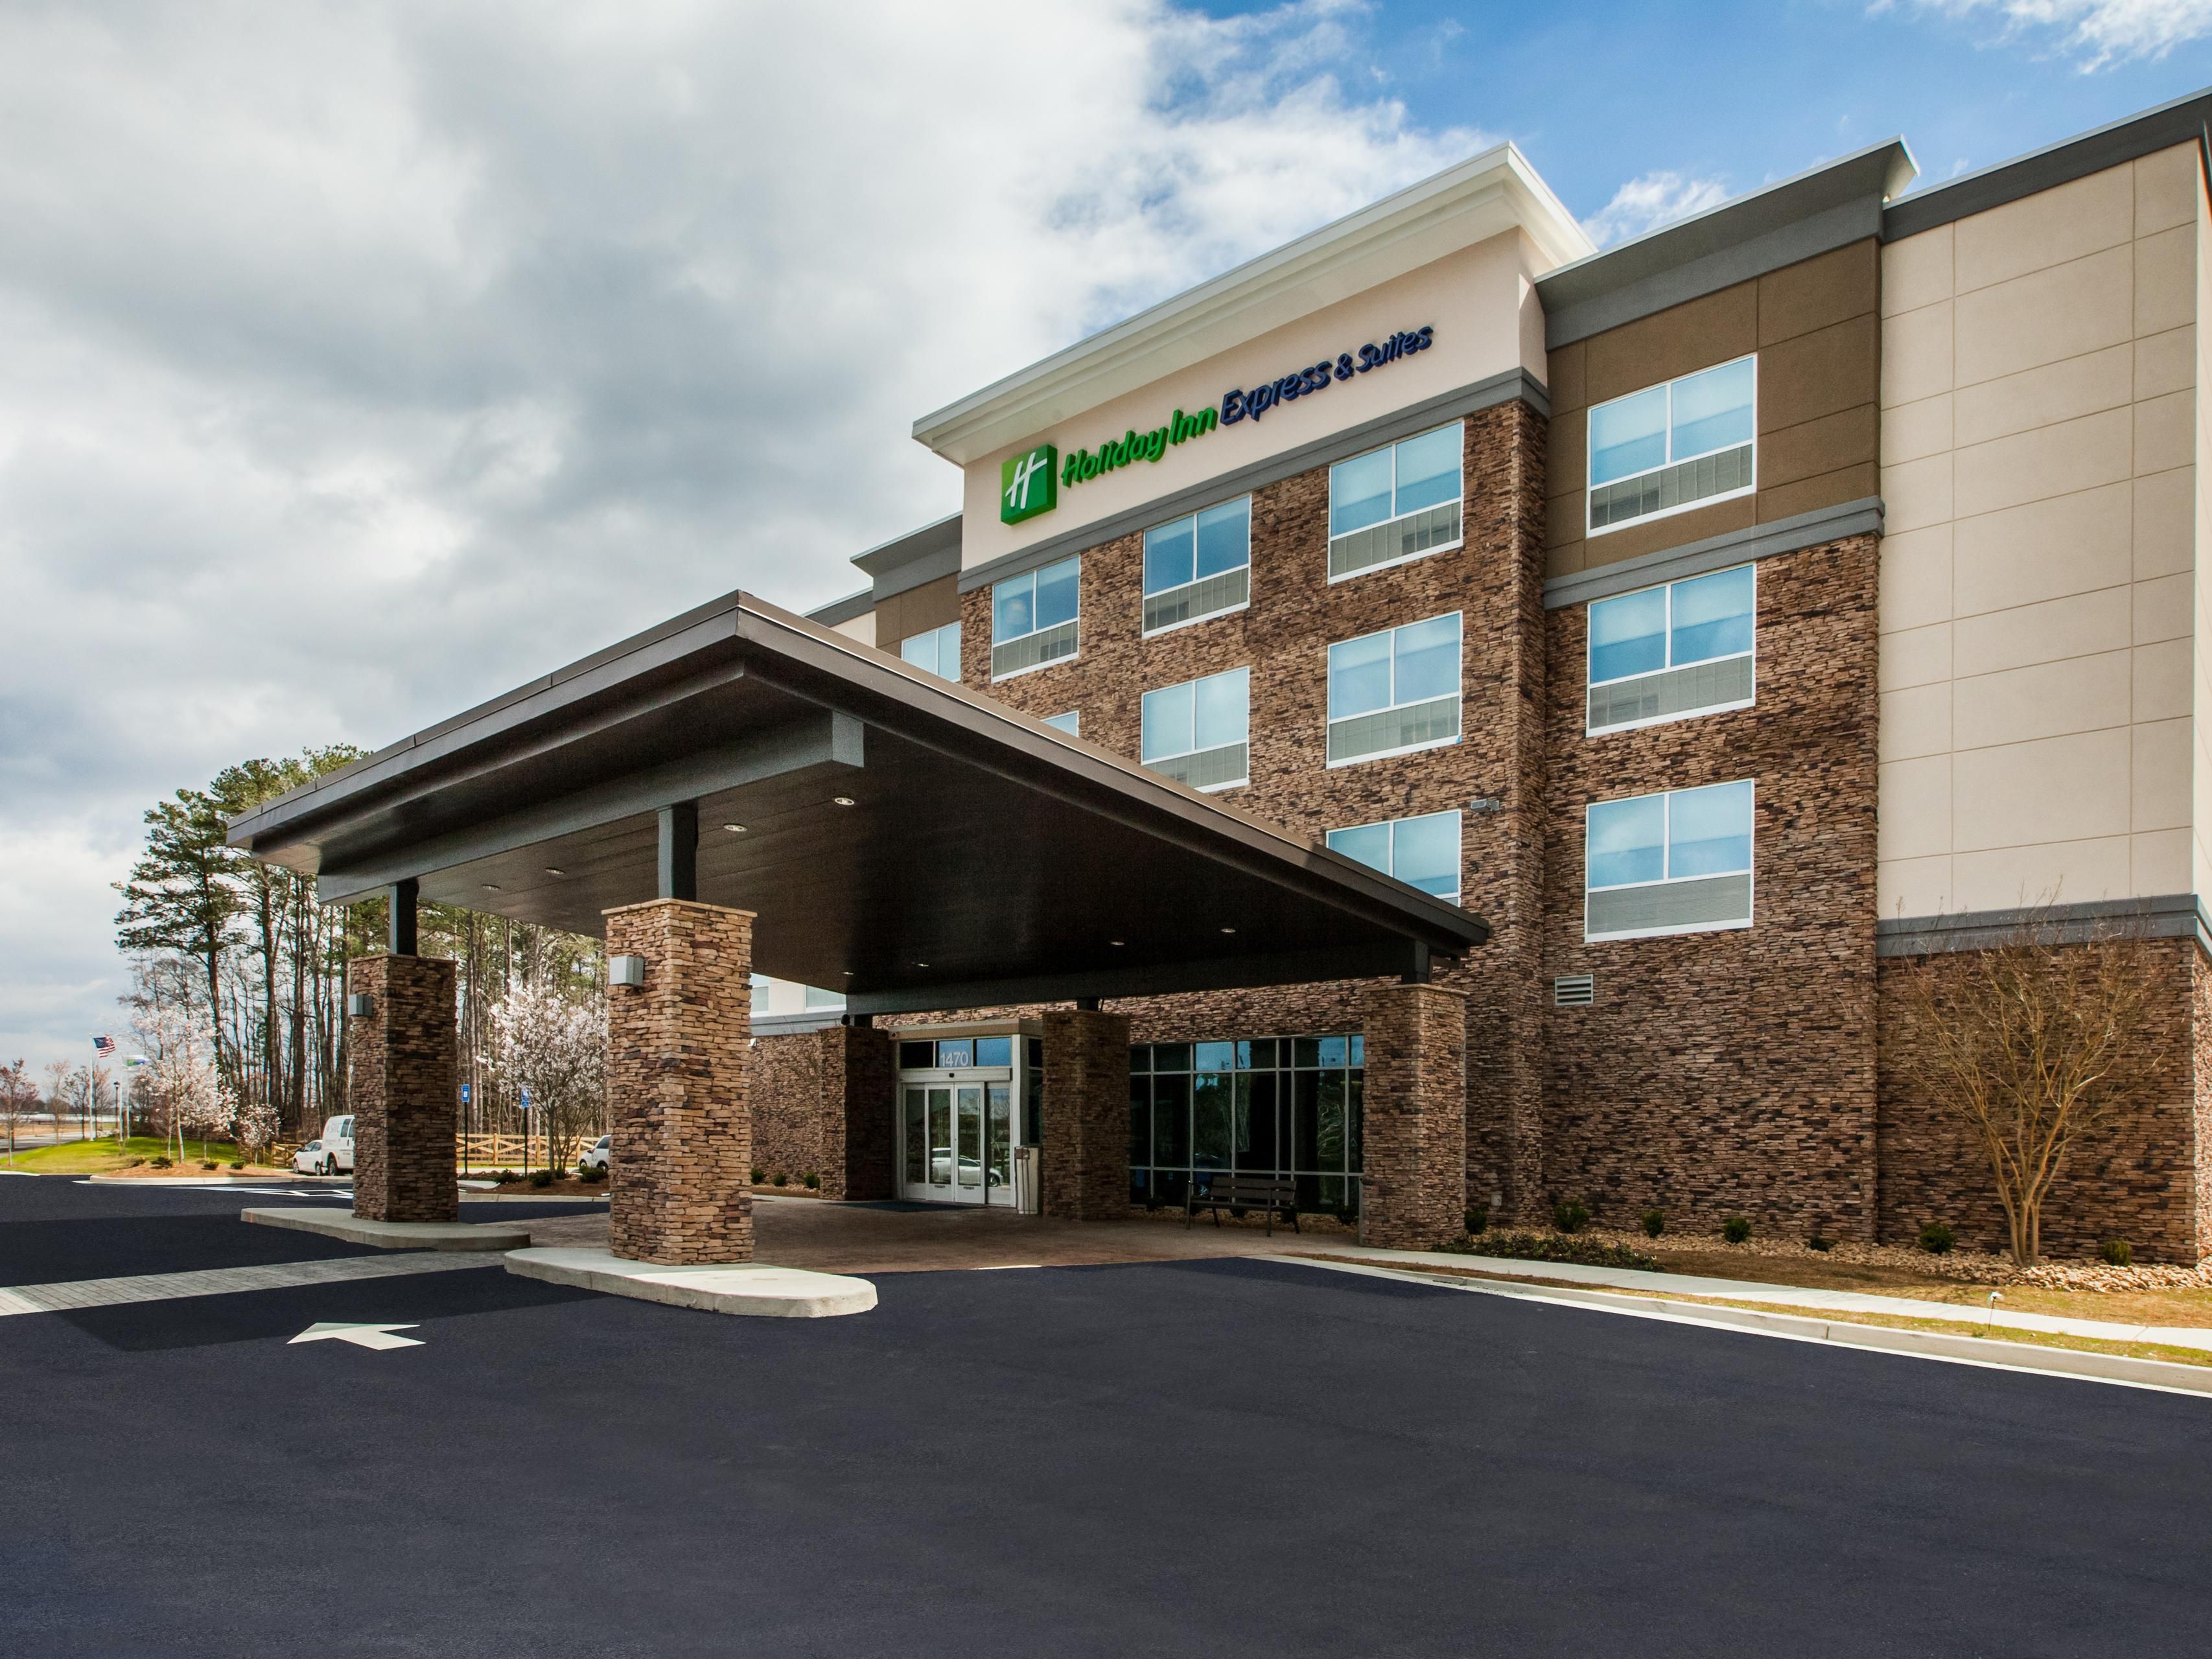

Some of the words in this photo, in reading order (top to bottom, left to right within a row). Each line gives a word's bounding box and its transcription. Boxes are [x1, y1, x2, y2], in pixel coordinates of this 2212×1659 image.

[1061, 426, 1169, 488] Holiday
[1169, 406, 1218, 445] Inn
[1220, 361, 1333, 426] Express
[1334, 353, 1355, 381] &
[1355, 326, 1434, 373] Suites
[940, 1051, 968, 1067] 1470
